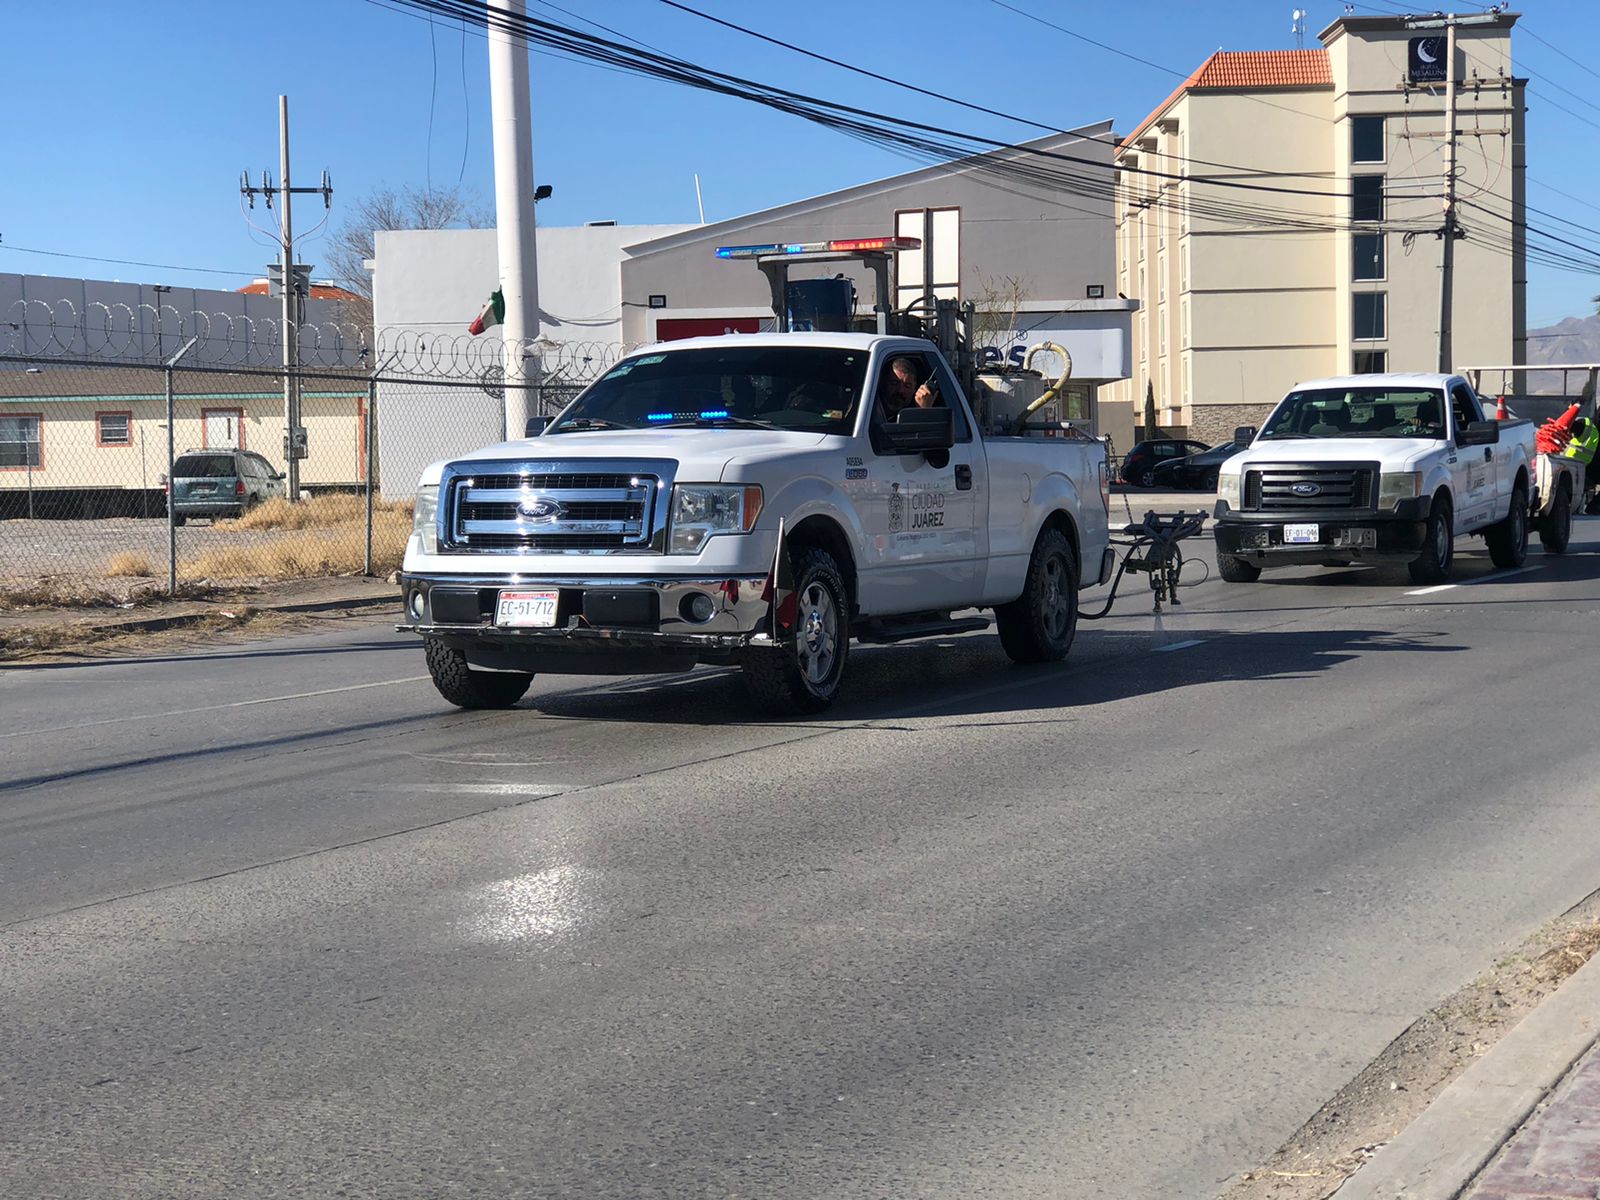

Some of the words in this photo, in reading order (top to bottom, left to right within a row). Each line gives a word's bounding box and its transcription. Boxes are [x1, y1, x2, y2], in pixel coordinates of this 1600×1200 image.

[912, 493, 945, 510] CIUDAD
[912, 509, 944, 529] JUÁREZ
[500, 601, 554, 615] EC-51-712
